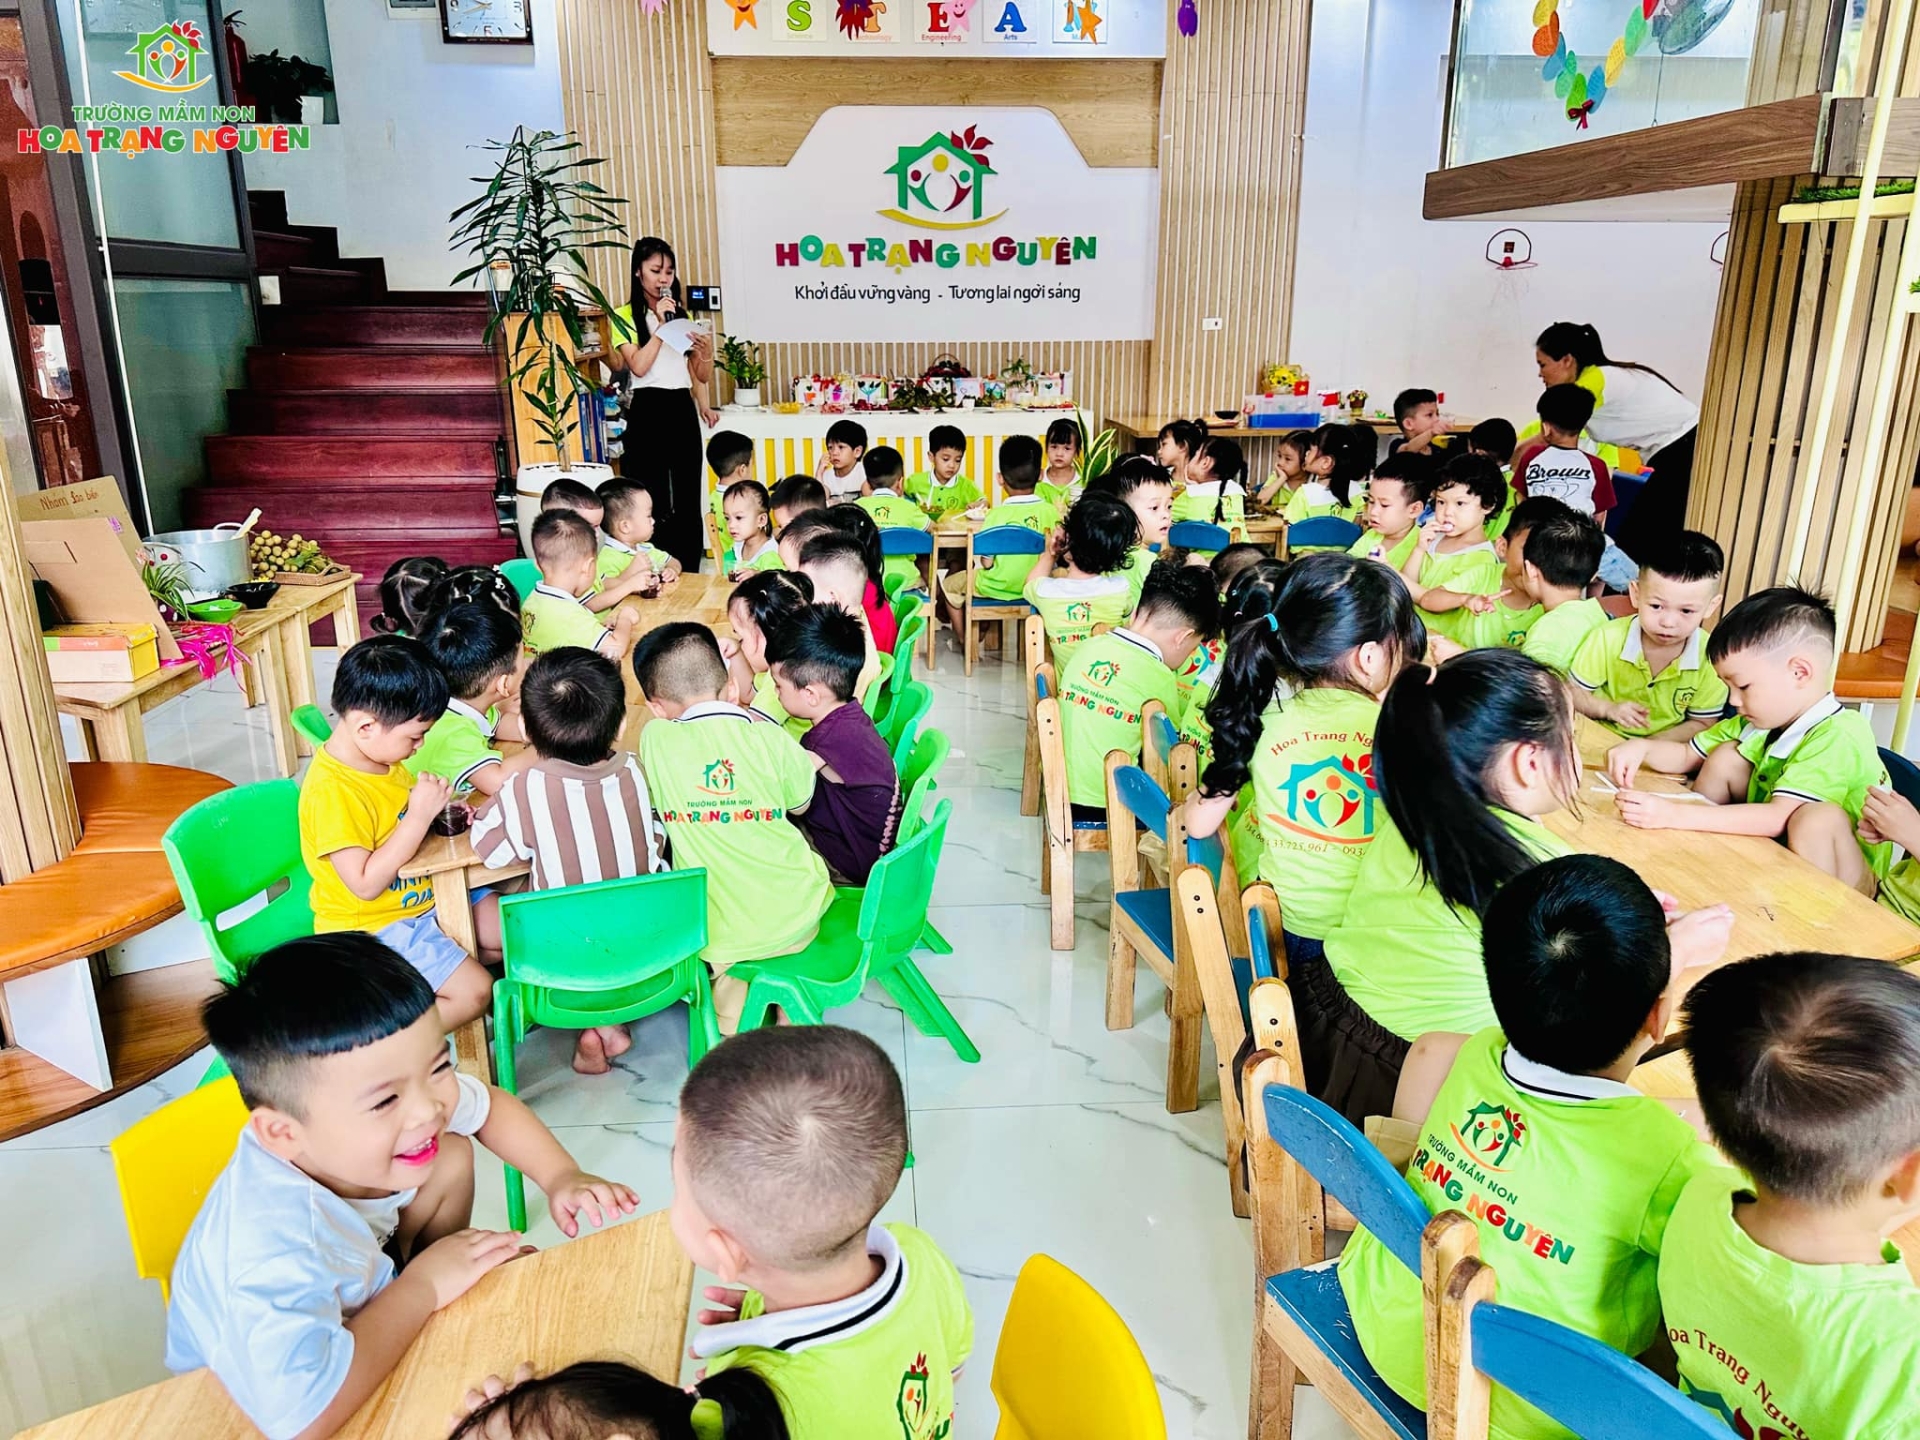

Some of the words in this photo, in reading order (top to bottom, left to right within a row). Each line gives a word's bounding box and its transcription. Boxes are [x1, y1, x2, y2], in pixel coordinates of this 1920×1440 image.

[786, 0, 812, 31] S
[927, 2, 951, 32] E
[994, 1, 1027, 32] A
[775, 235, 845, 267] HOA
[848, 237, 960, 275] TRẠNG
[966, 236, 1097, 267] NGUYÊN
[795, 281, 828, 299] Khởi
[830, 283, 856, 300] đầu
[858, 284, 896, 303] vững
[897, 285, 931, 303] vàng
[948, 285, 995, 303] Tương
[996, 284, 1011, 299] lai
[1013, 283, 1046, 303] ngời
[1047, 282, 1081, 303] sáng
[1526, 464, 1591, 481] Brown
[1270, 738, 1299, 756] Hoa
[1353, 731, 1373, 747] Ng
[1427, 1133, 1456, 1162] TRƯỜNG
[1487, 1180, 1519, 1205] NON
[1466, 1193, 1576, 1265] NGUYÊN
[1669, 1328, 1690, 1344] oa
